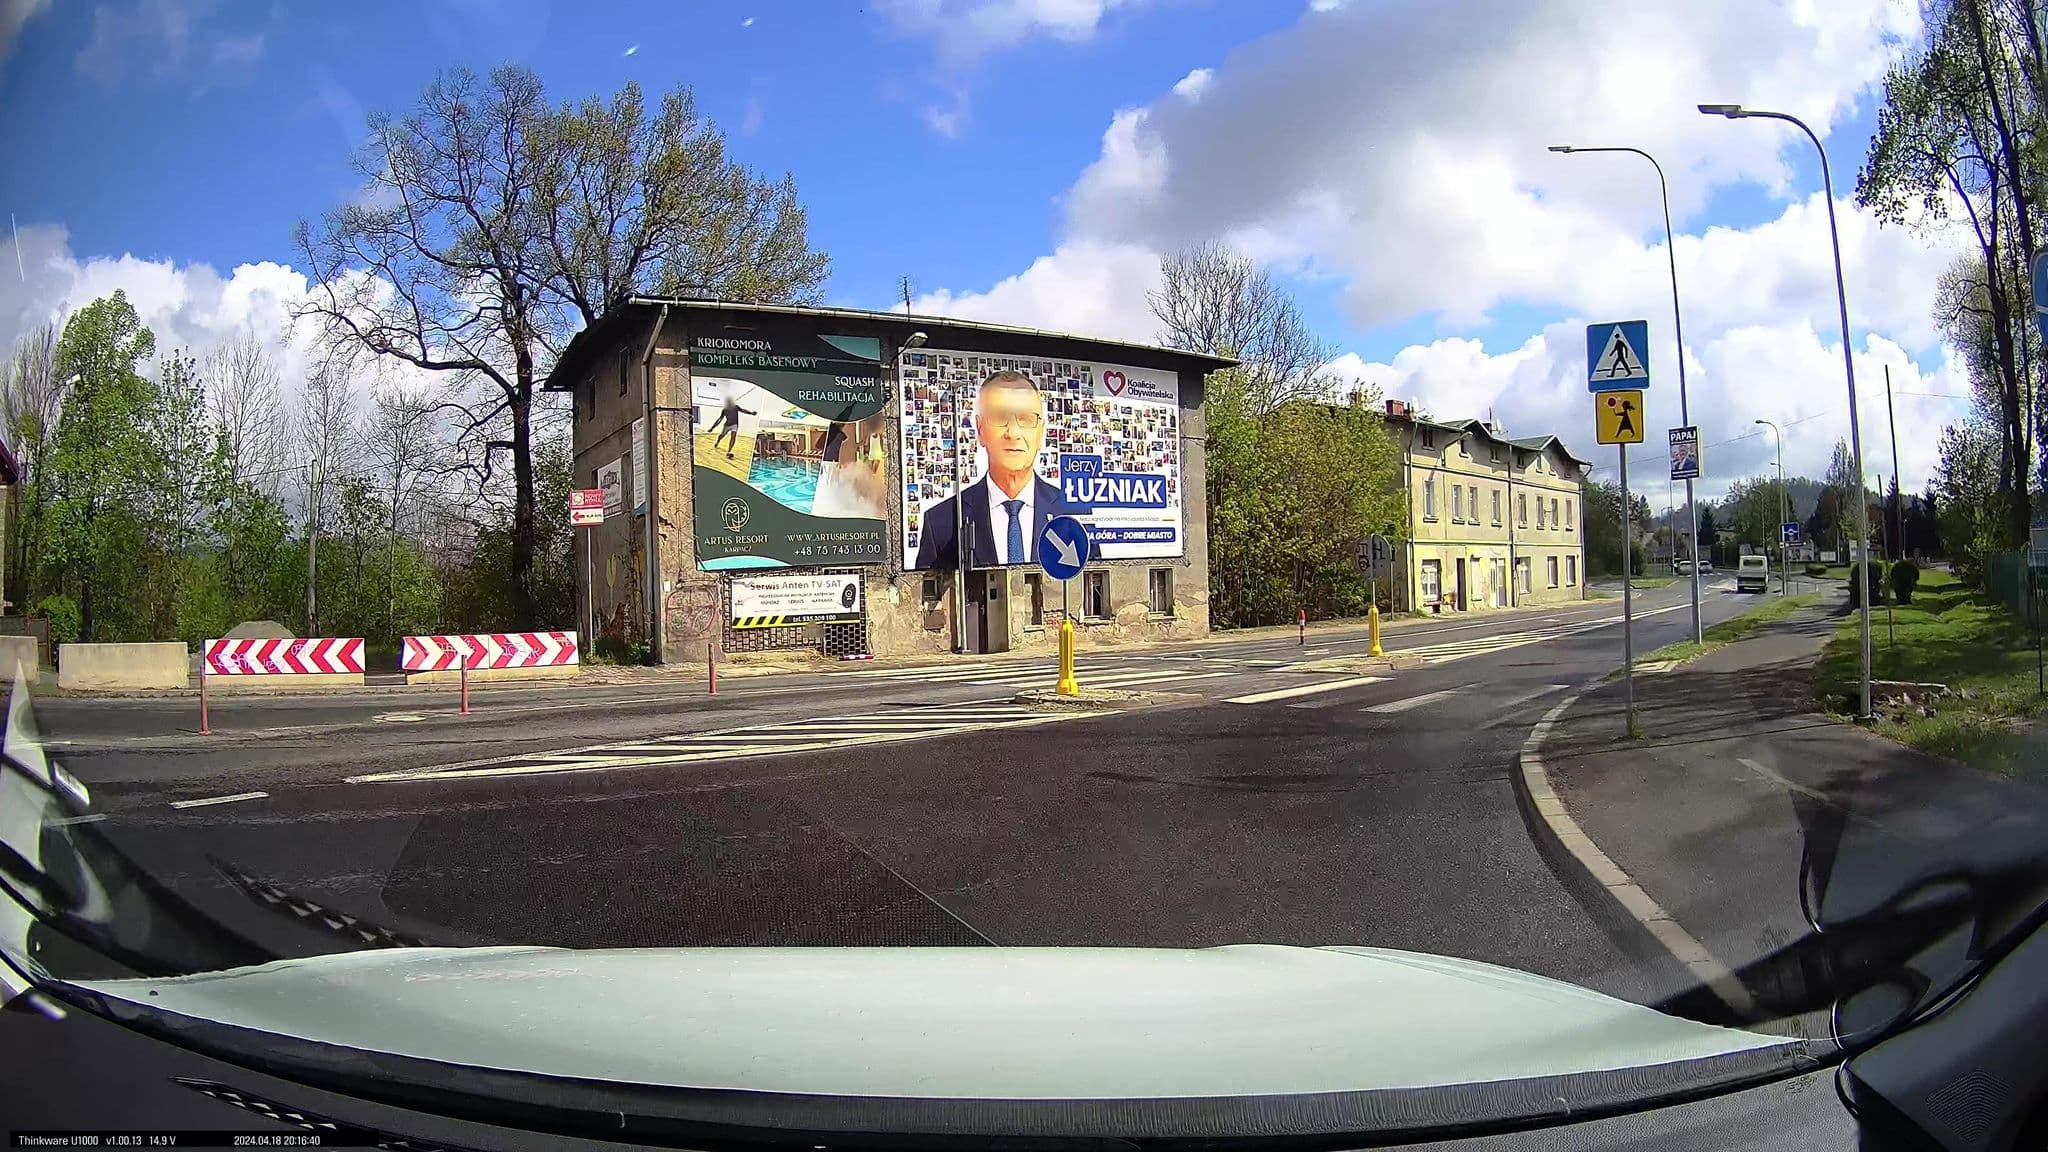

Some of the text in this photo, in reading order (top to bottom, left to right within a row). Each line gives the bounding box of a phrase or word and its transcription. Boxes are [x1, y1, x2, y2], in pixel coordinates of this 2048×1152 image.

[697, 337, 772, 350] KRIOKOMORA
[697, 353, 818, 369] KOMPLEKS BASENOWY
[834, 376, 875, 389] SQUASH
[1127, 379, 1156, 391] Koalicja
[798, 390, 875, 403] REHABILITACJA
[1127, 386, 1174, 399] Obywatelska
[1670, 430, 1696, 441] PAPAJ
[1064, 457, 1098, 476] Jerzy
[1064, 471, 1164, 504] ŁUŻNIAK
[704, 534, 769, 545] ARTUS RESORT
[785, 532, 880, 543] WWW.ARTUSRESORT.PL
[1095, 529, 1117, 540] GÓRA
[1123, 531, 1147, 540] DOBRE
[1147, 531, 1173, 540] MIASTO
[794, 546, 812, 556] +48
[816, 546, 828, 555] 75
[832, 545, 850, 555] 743
[867, 544, 881, 554] 00
[750, 582, 780, 591] Serwis
[782, 580, 809, 590] Anten
